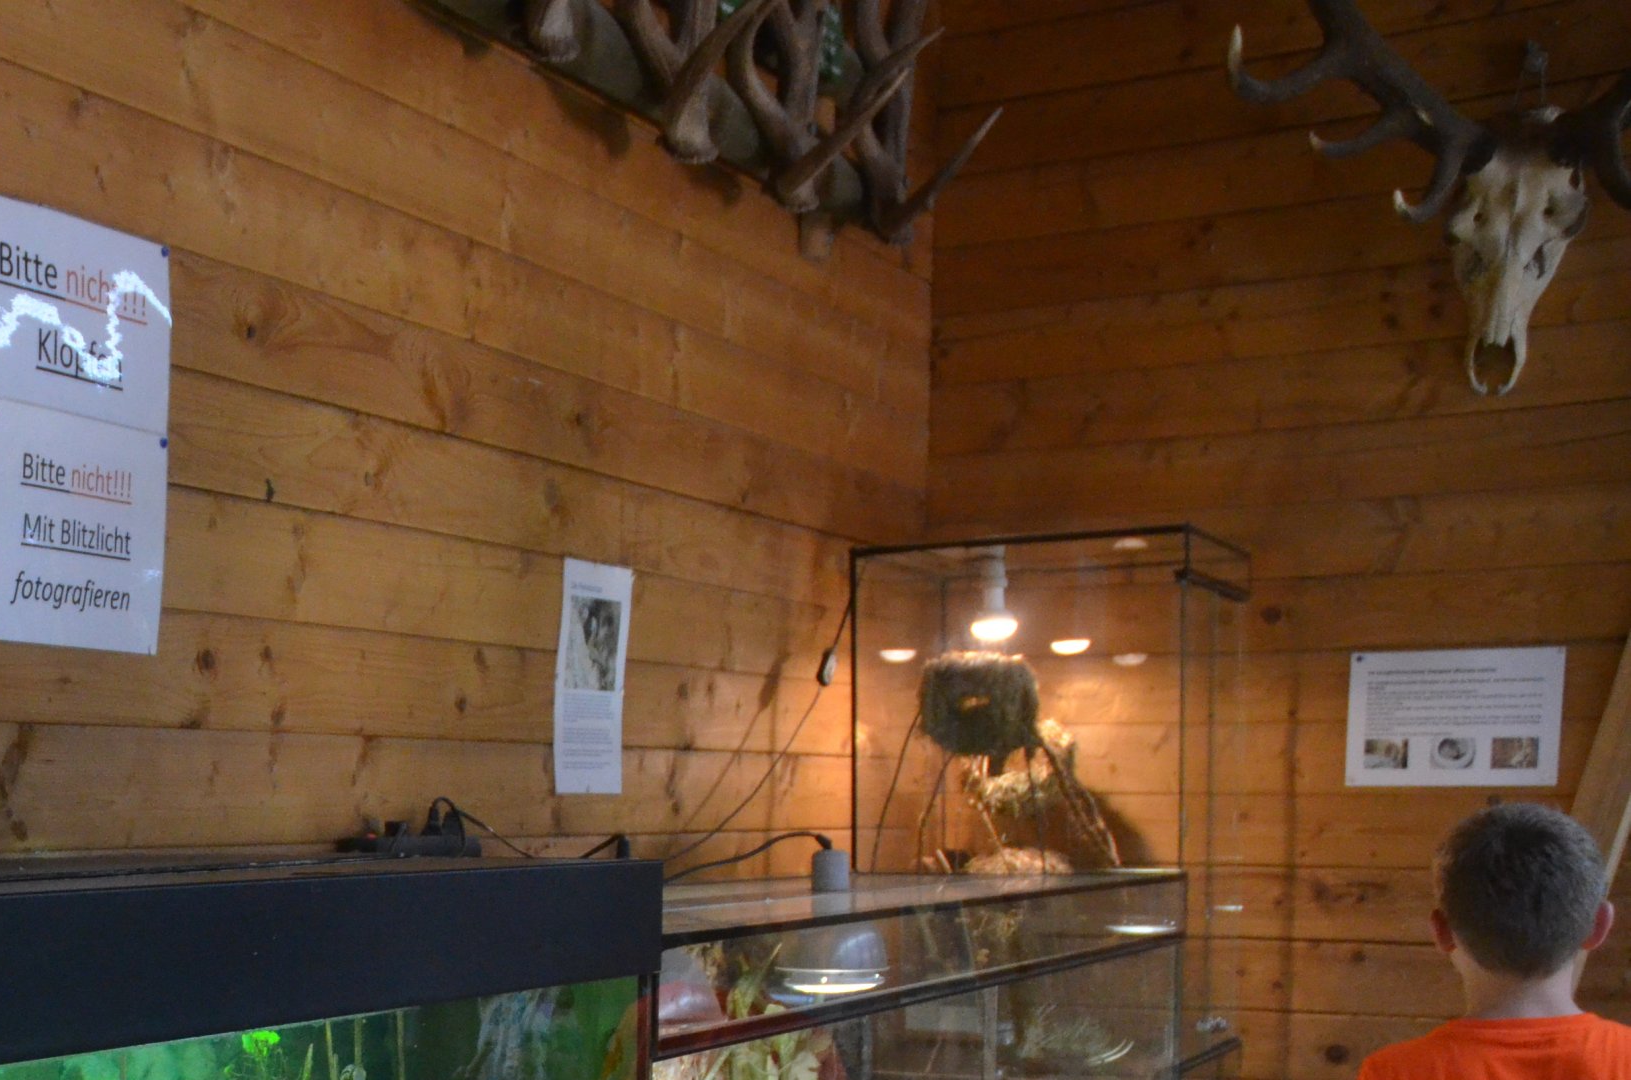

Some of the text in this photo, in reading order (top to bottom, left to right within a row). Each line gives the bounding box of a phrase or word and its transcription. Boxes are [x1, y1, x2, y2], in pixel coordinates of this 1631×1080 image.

[0, 240, 57, 289] Bitte
[22, 452, 132, 498] Bitte nicht!!!
[23, 513, 131, 556] Mit Blitzlicht
[11, 571, 131, 611] fotografieren
